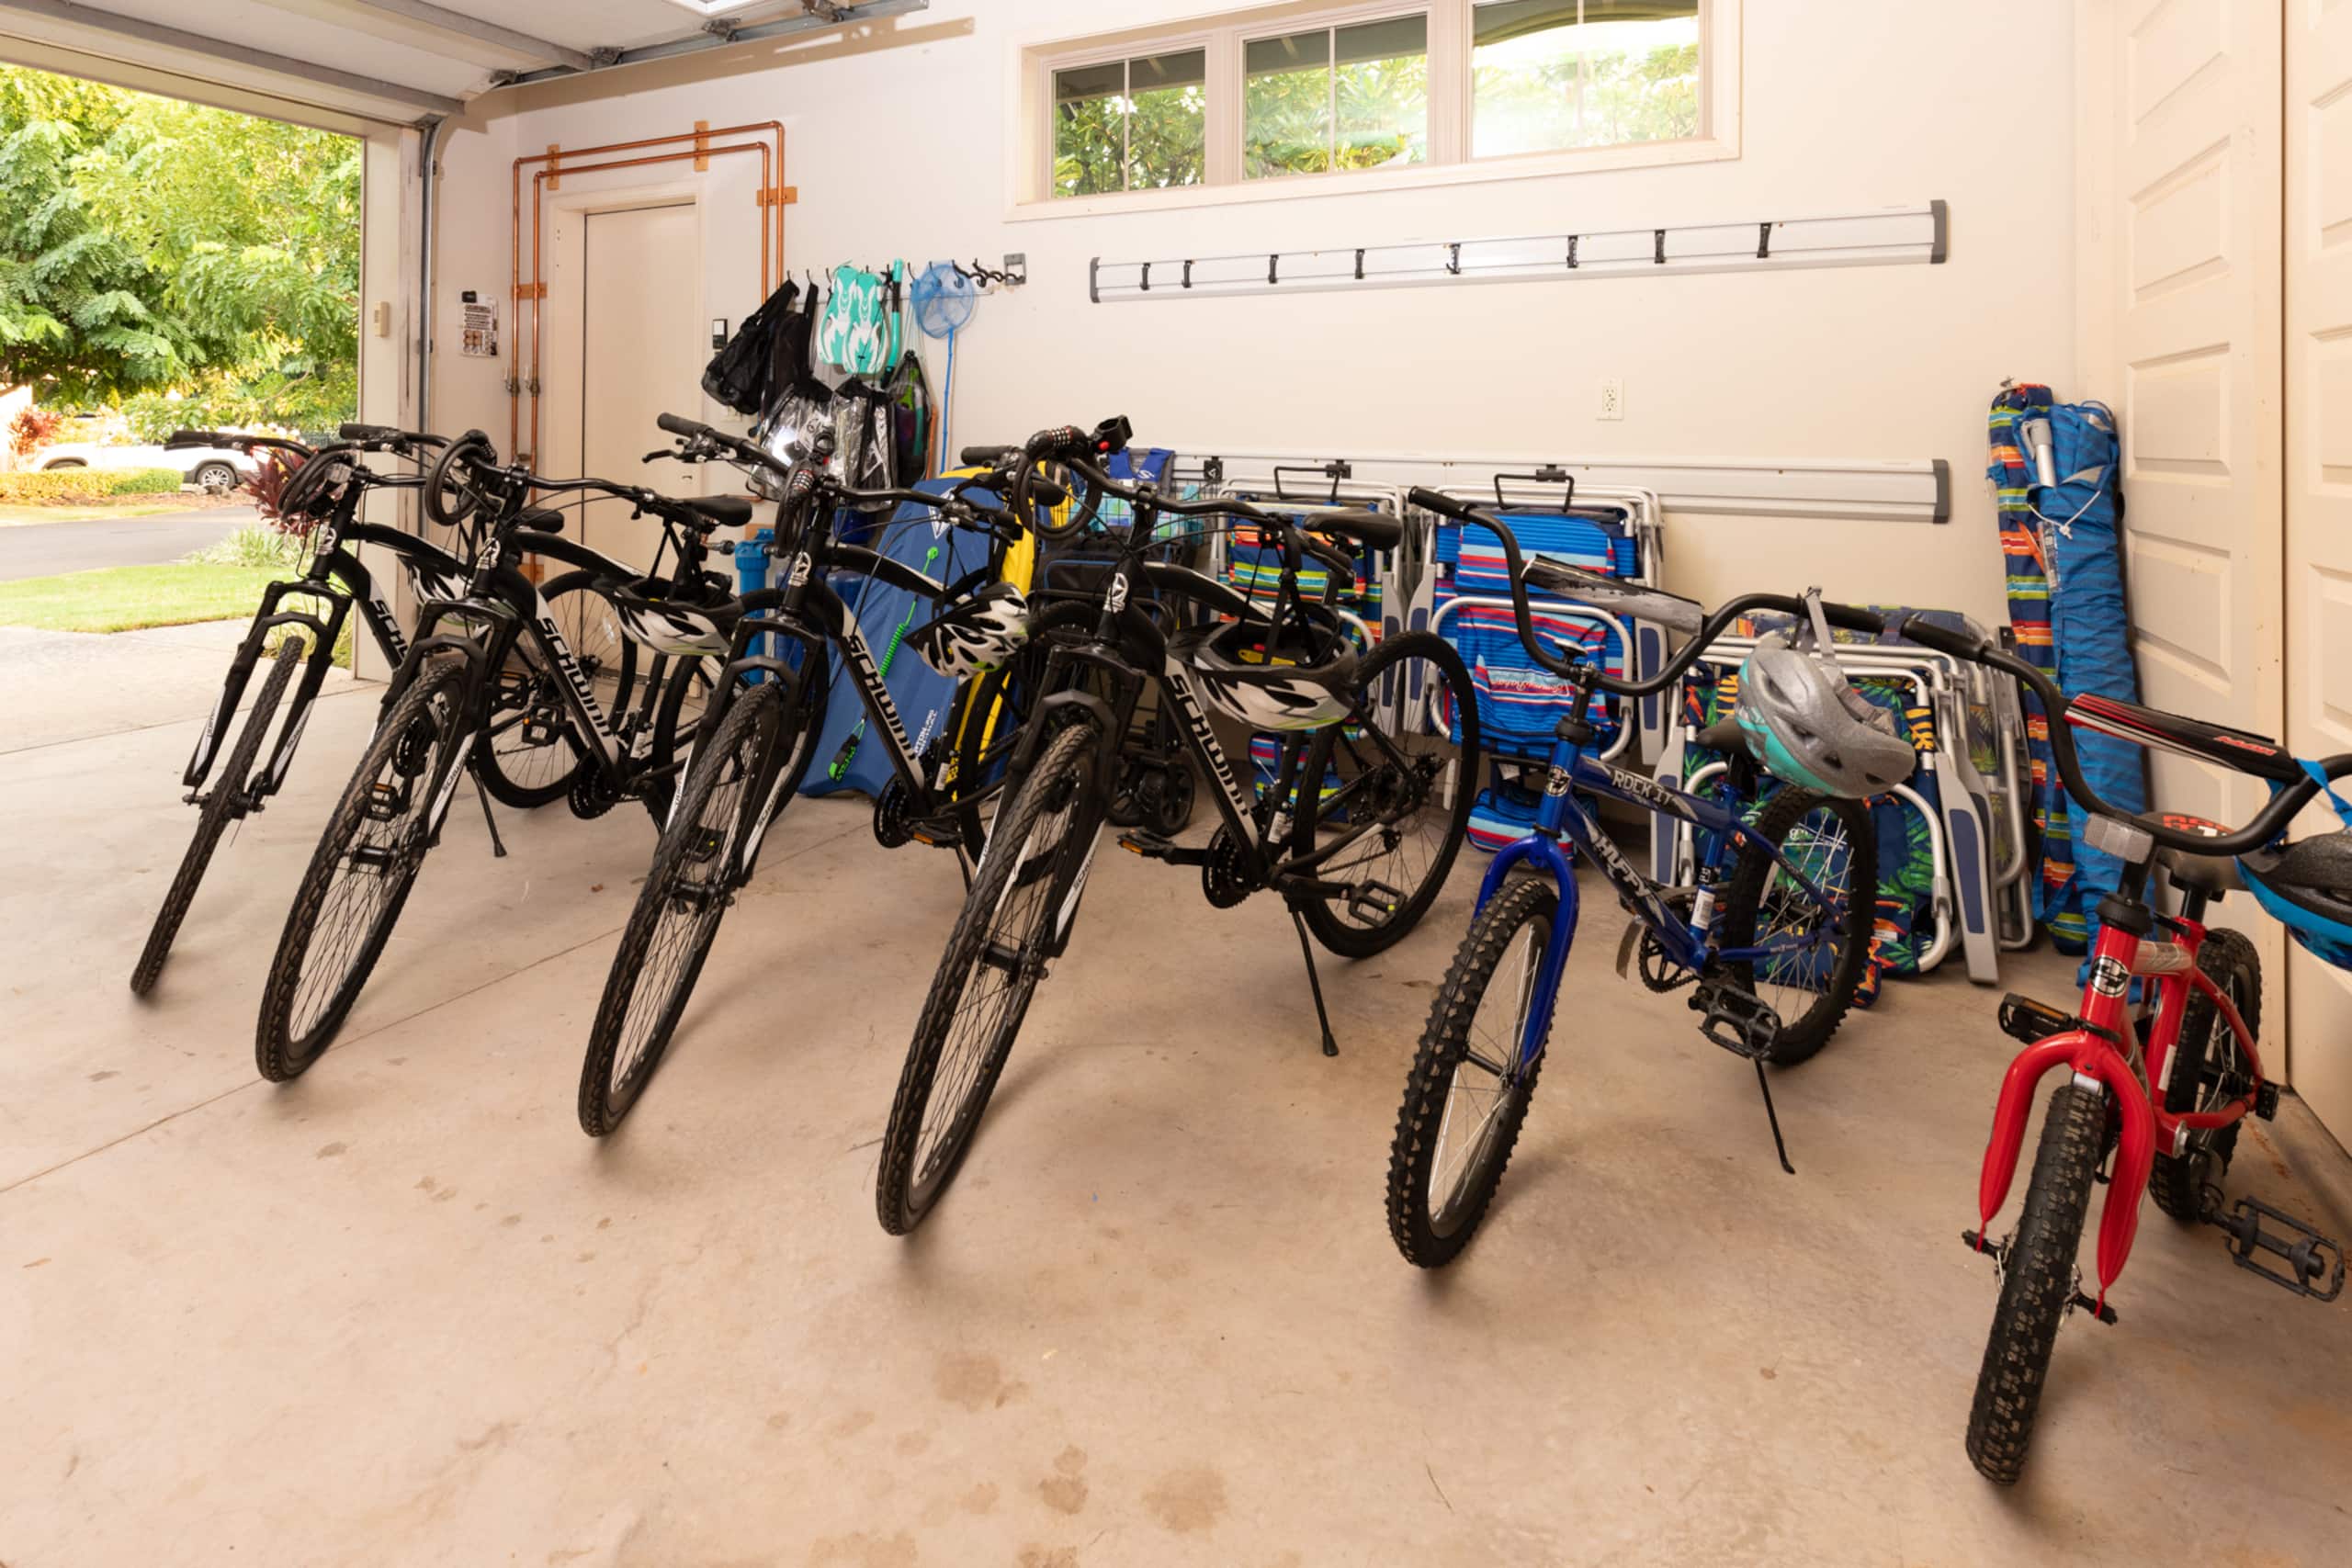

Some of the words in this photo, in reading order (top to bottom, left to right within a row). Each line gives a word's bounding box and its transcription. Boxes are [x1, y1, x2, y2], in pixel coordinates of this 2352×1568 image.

[537, 617, 612, 737] SCHWINN
[847, 634, 916, 761] SCHWINN
[1167, 674, 1249, 816] SCHWINN
[1611, 770, 1652, 797] ROCK
[1654, 784, 1674, 806] IT
[1594, 836, 1652, 897] HUFFY
